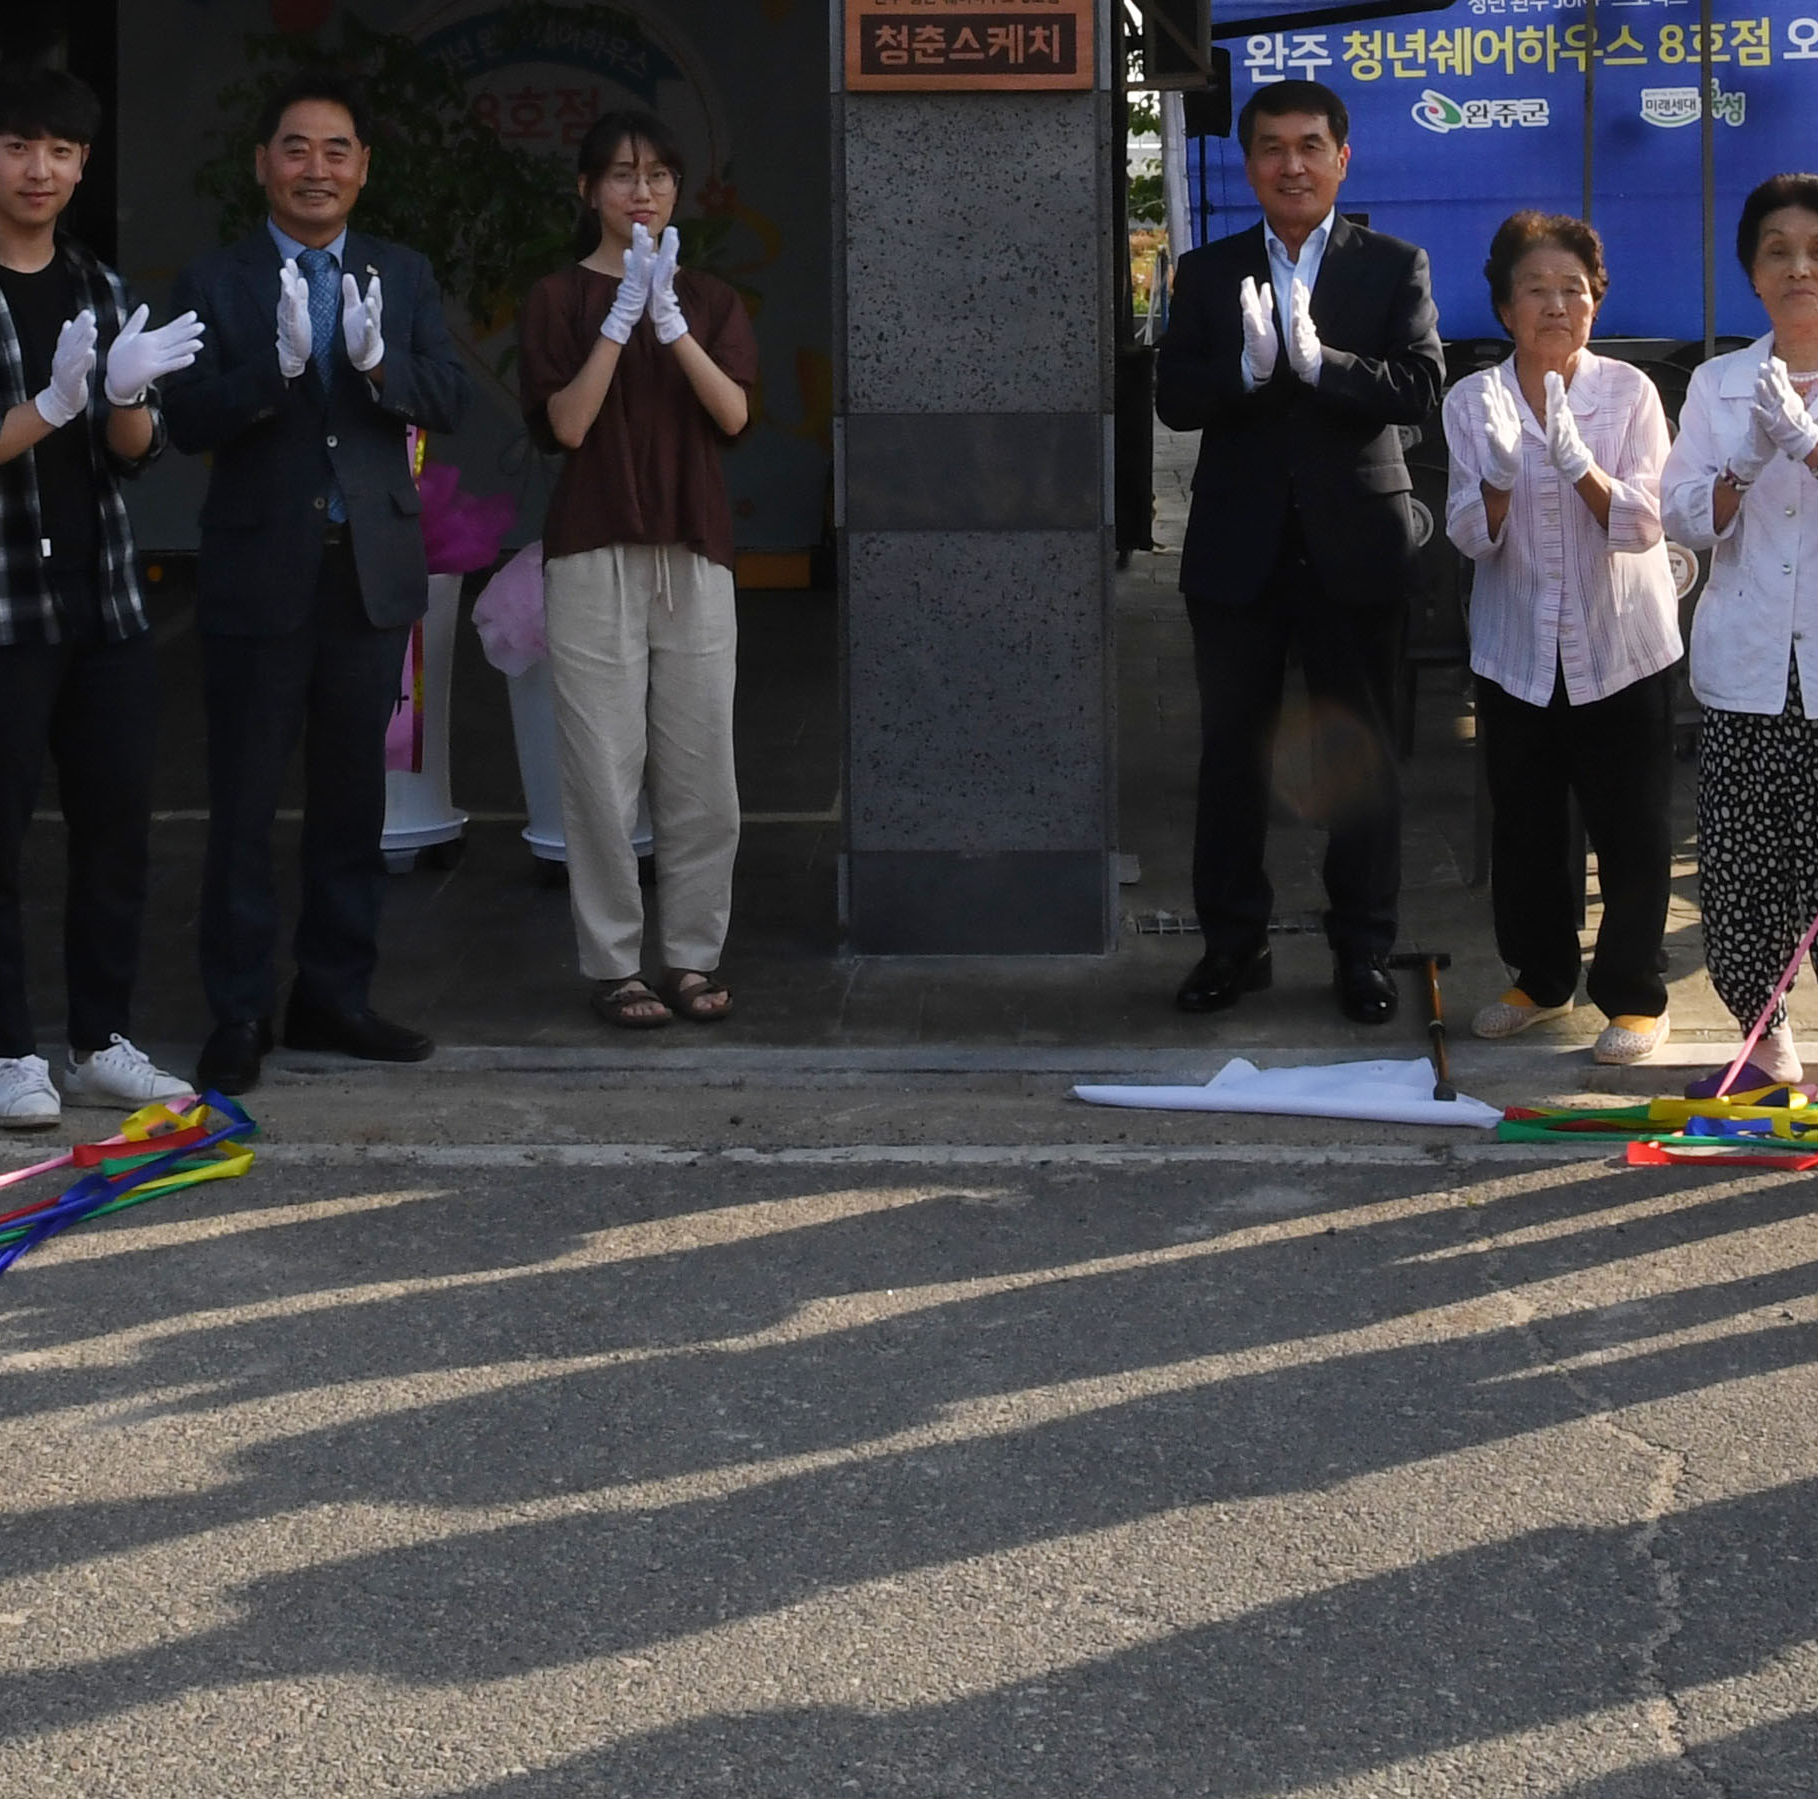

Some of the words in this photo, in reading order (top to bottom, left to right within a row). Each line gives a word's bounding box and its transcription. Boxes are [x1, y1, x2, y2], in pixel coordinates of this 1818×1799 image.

[874, 23, 1061, 65] 청춘스케치
[1243, 33, 1333, 83] 완주
[1342, 24, 1649, 81] 청년쉐어하우스
[1658, 16, 1772, 67] 8호점
[1465, 102, 1547, 125] 완주군
[1645, 98, 1697, 112] 미래세대
